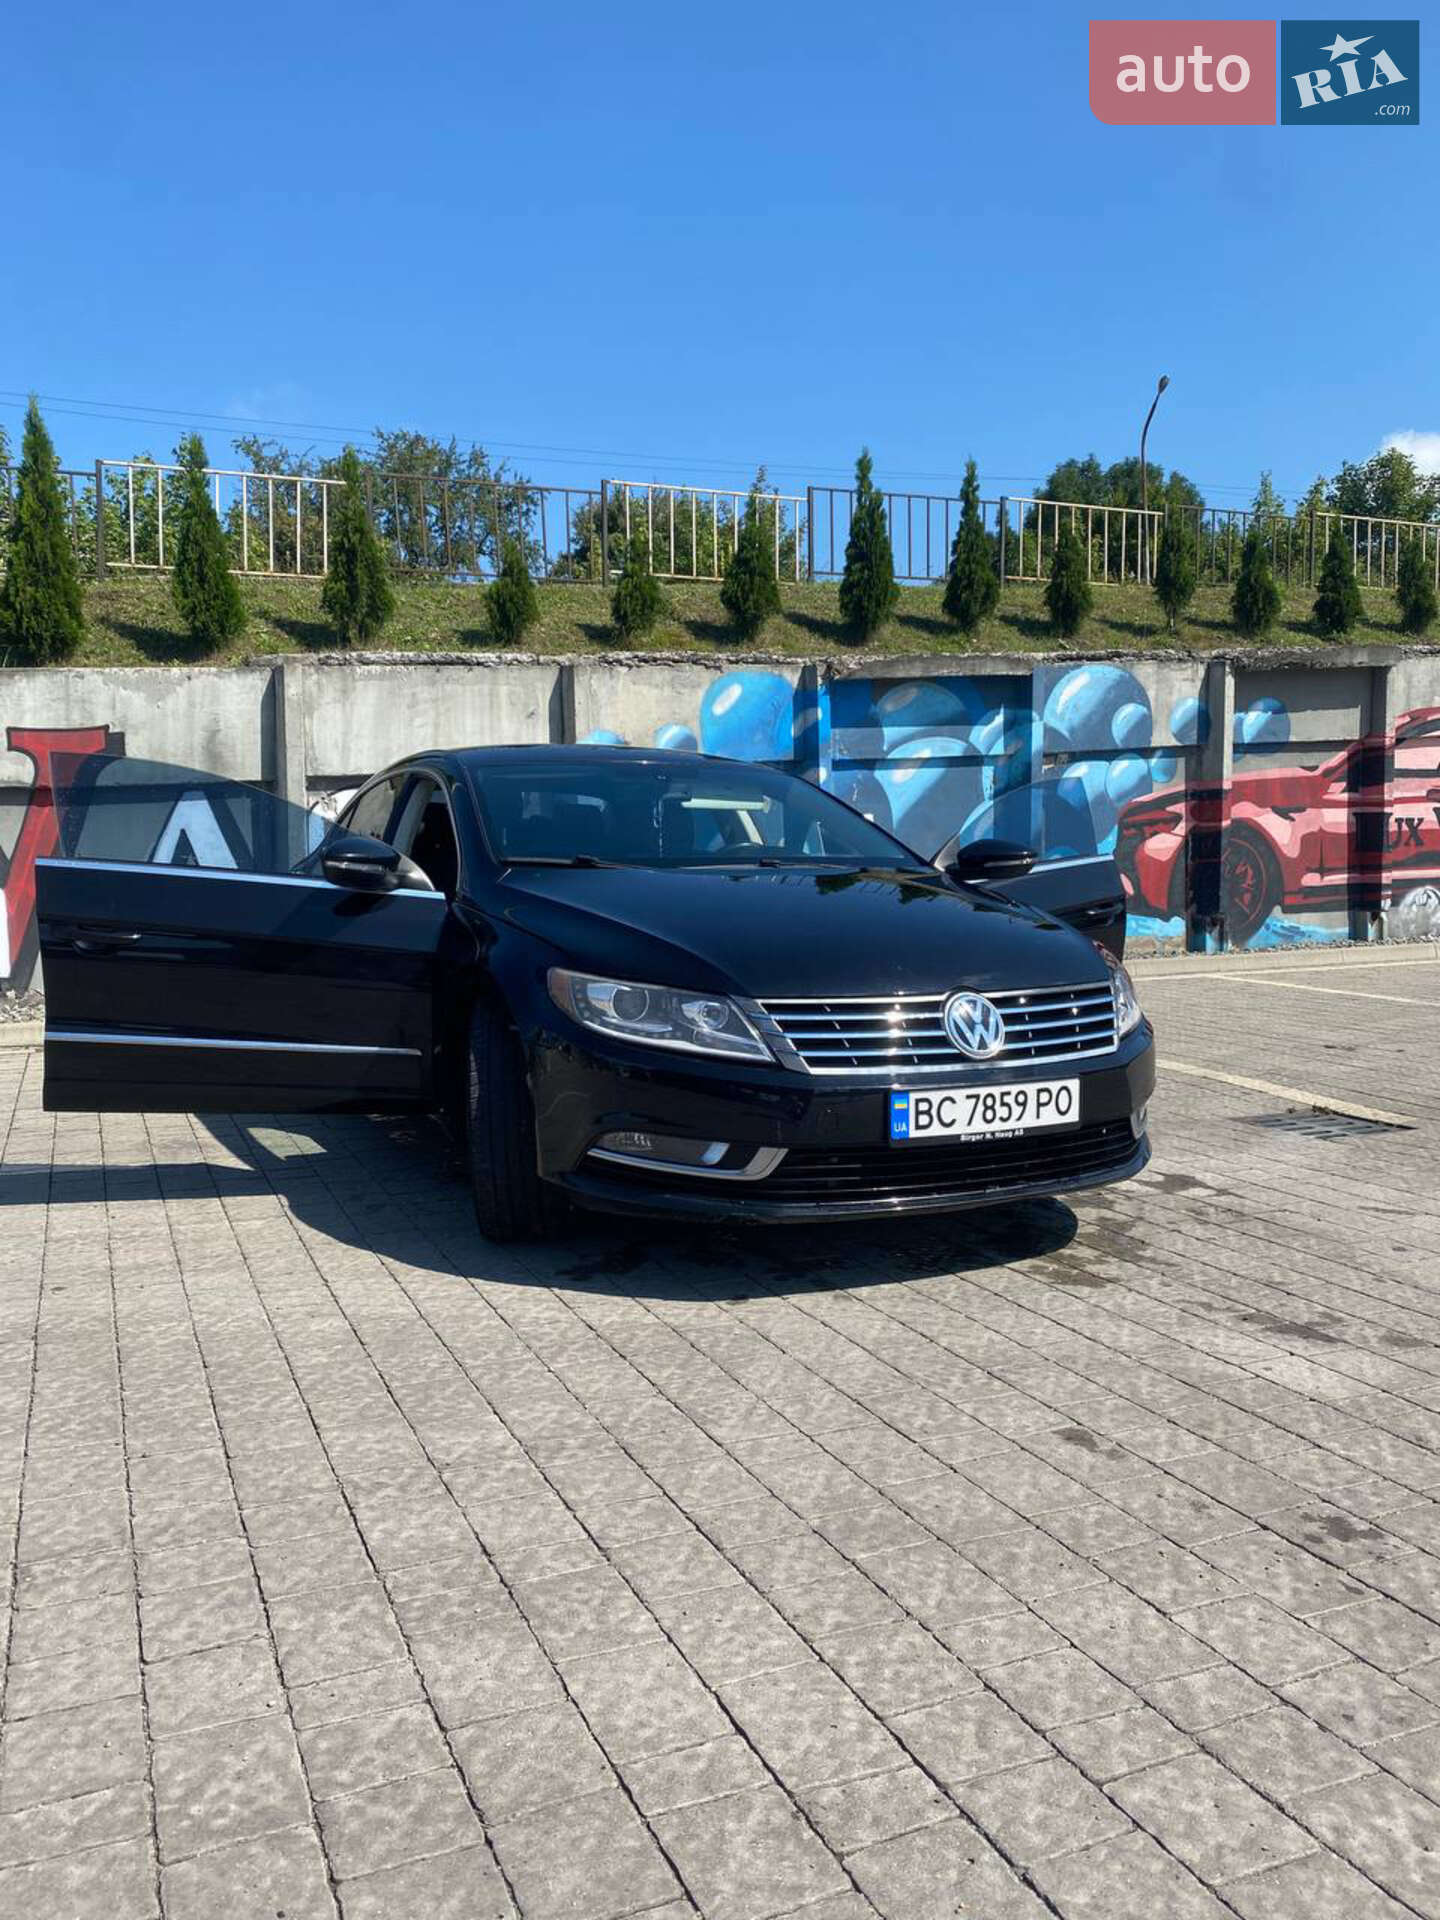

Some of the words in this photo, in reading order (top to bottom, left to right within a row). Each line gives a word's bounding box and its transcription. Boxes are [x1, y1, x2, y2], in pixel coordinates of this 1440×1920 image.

[946, 993, 1003, 1057] VW
[893, 1122, 908, 1133] UA
[914, 1096, 957, 1131] BC
[965, 1090, 1029, 1127] 7859
[1035, 1085, 1073, 1120] PO
